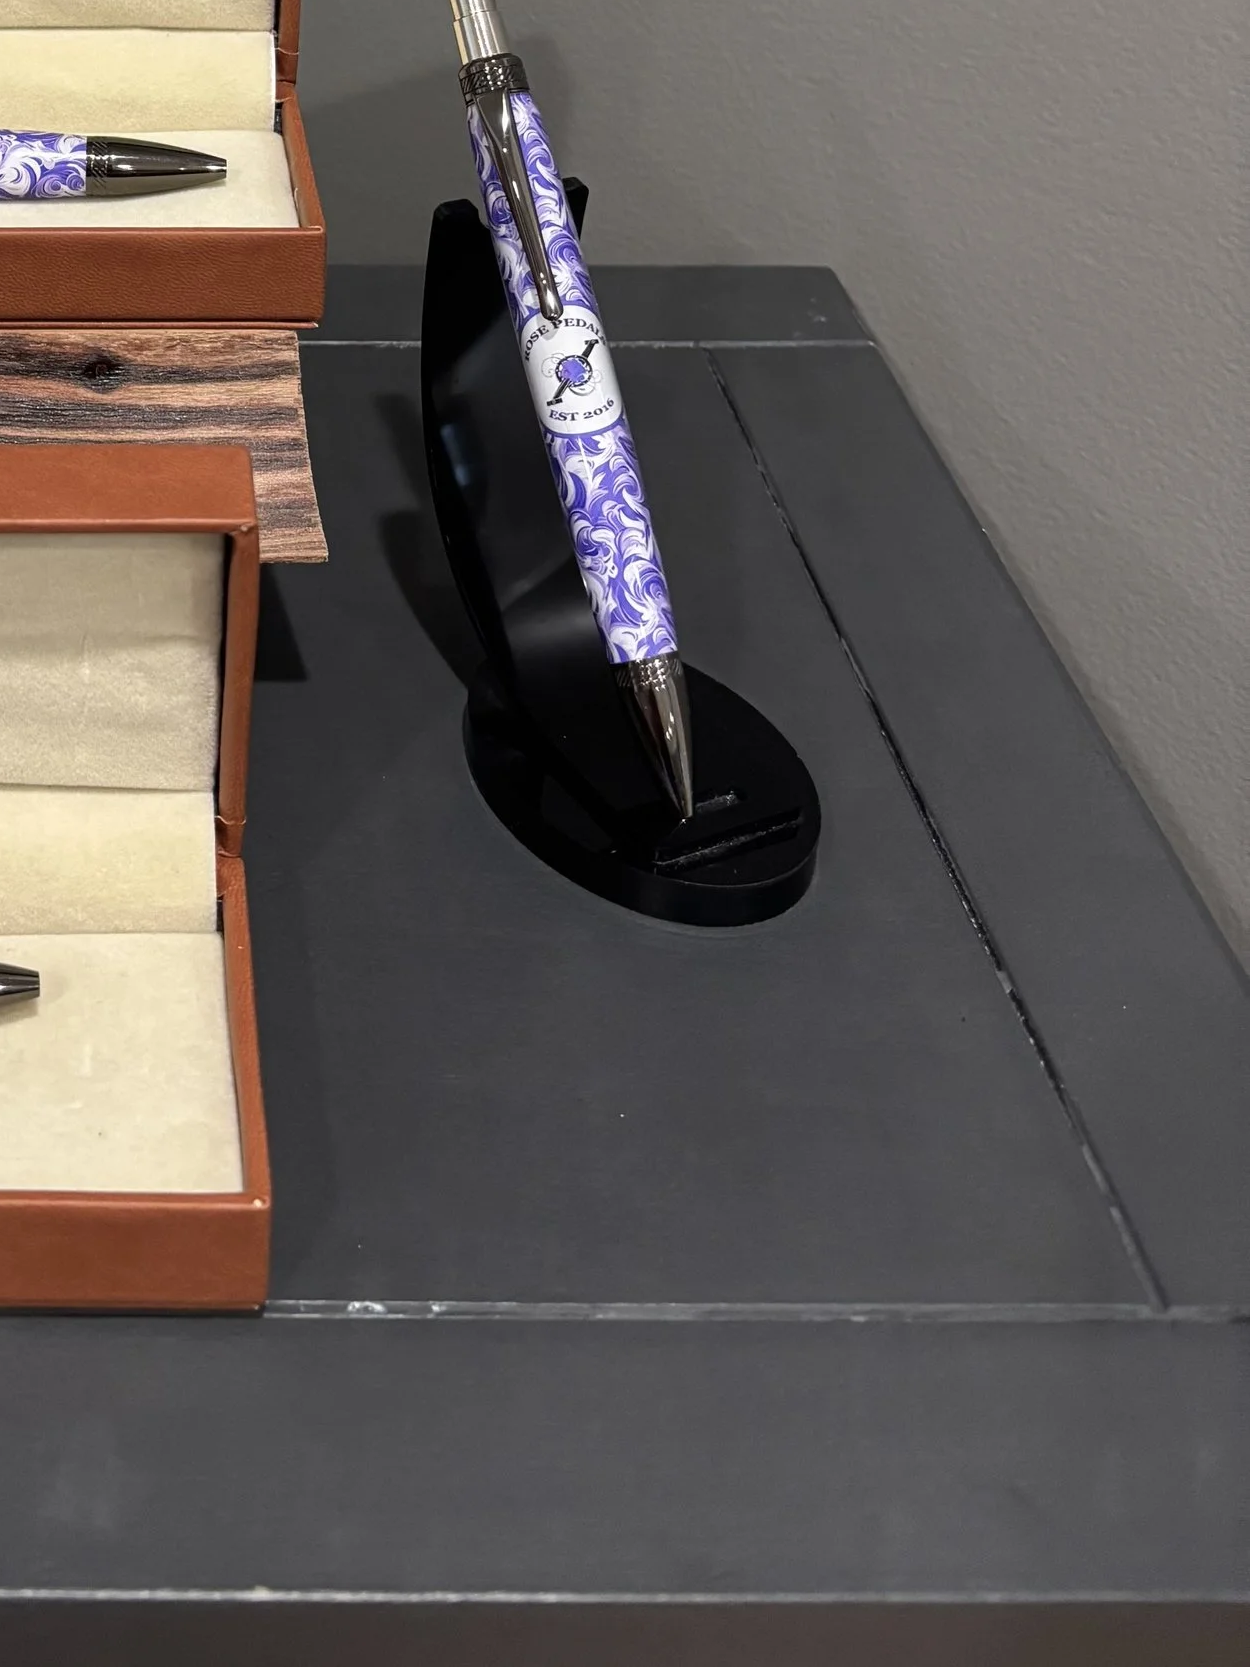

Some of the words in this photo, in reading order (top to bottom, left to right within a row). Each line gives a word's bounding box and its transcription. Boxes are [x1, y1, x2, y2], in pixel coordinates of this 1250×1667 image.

[524, 325, 549, 362] ROSE
[551, 317, 608, 346] PEDALS
[548, 409, 580, 422] EST
[583, 398, 615, 420] 2016
